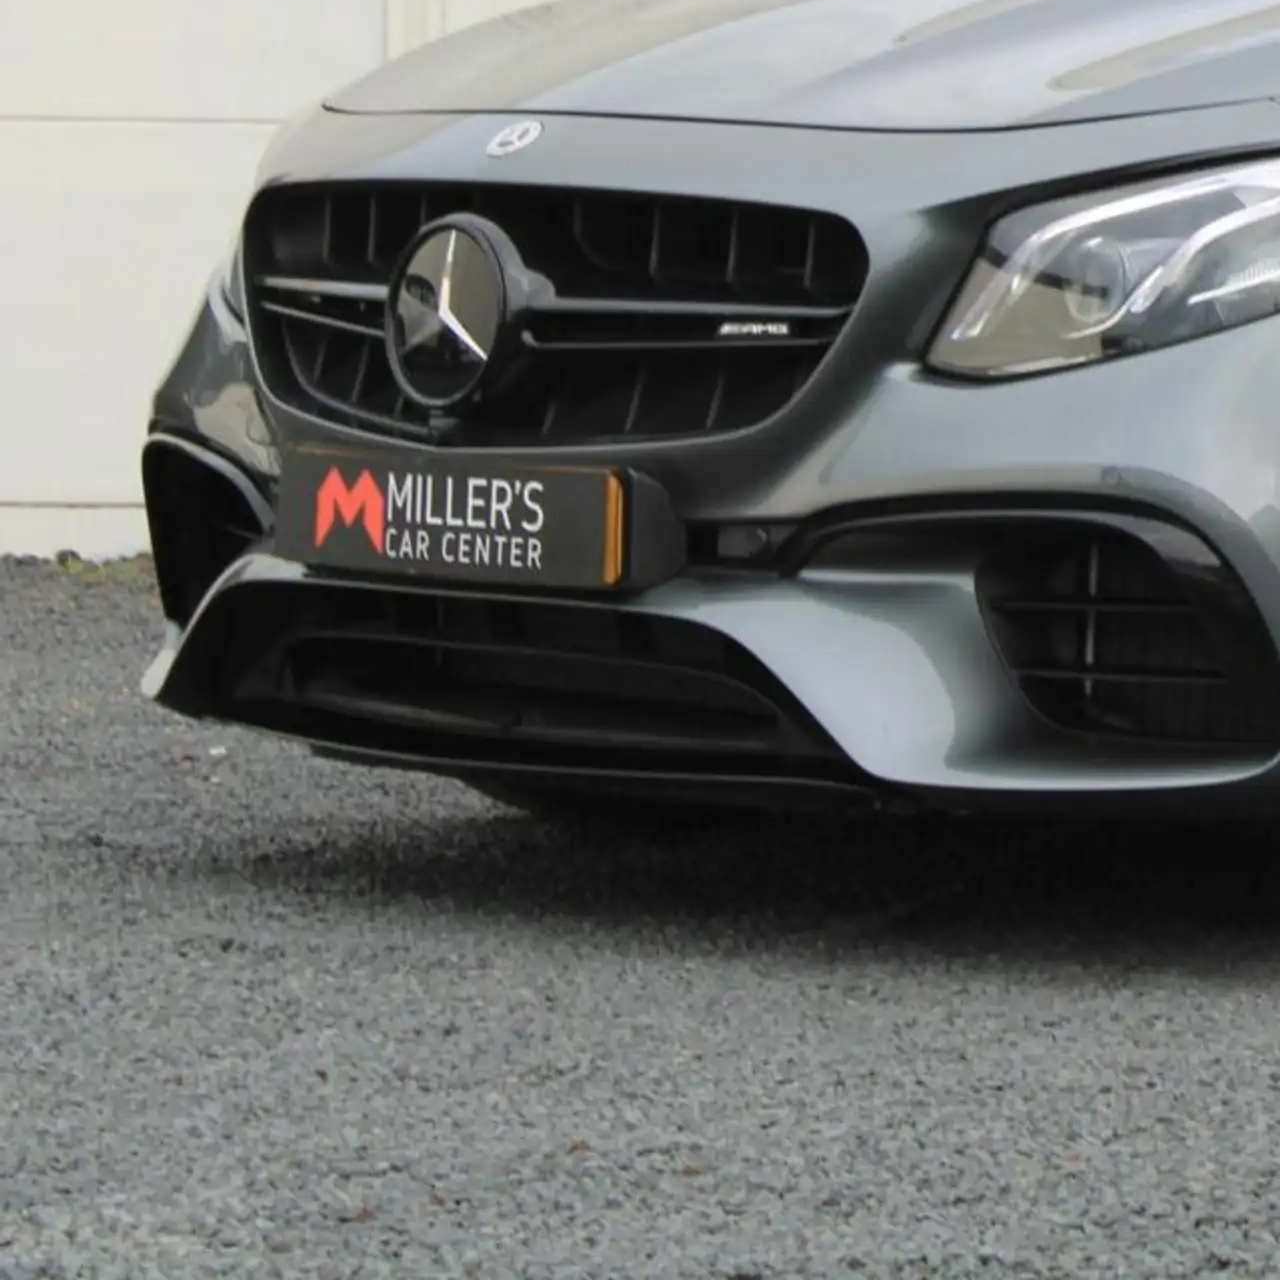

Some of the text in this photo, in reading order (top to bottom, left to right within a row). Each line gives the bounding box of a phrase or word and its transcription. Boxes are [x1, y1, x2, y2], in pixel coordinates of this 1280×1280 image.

[387, 471, 545, 533] MILLER'S
[385, 527, 543, 570] CAR CENTER
